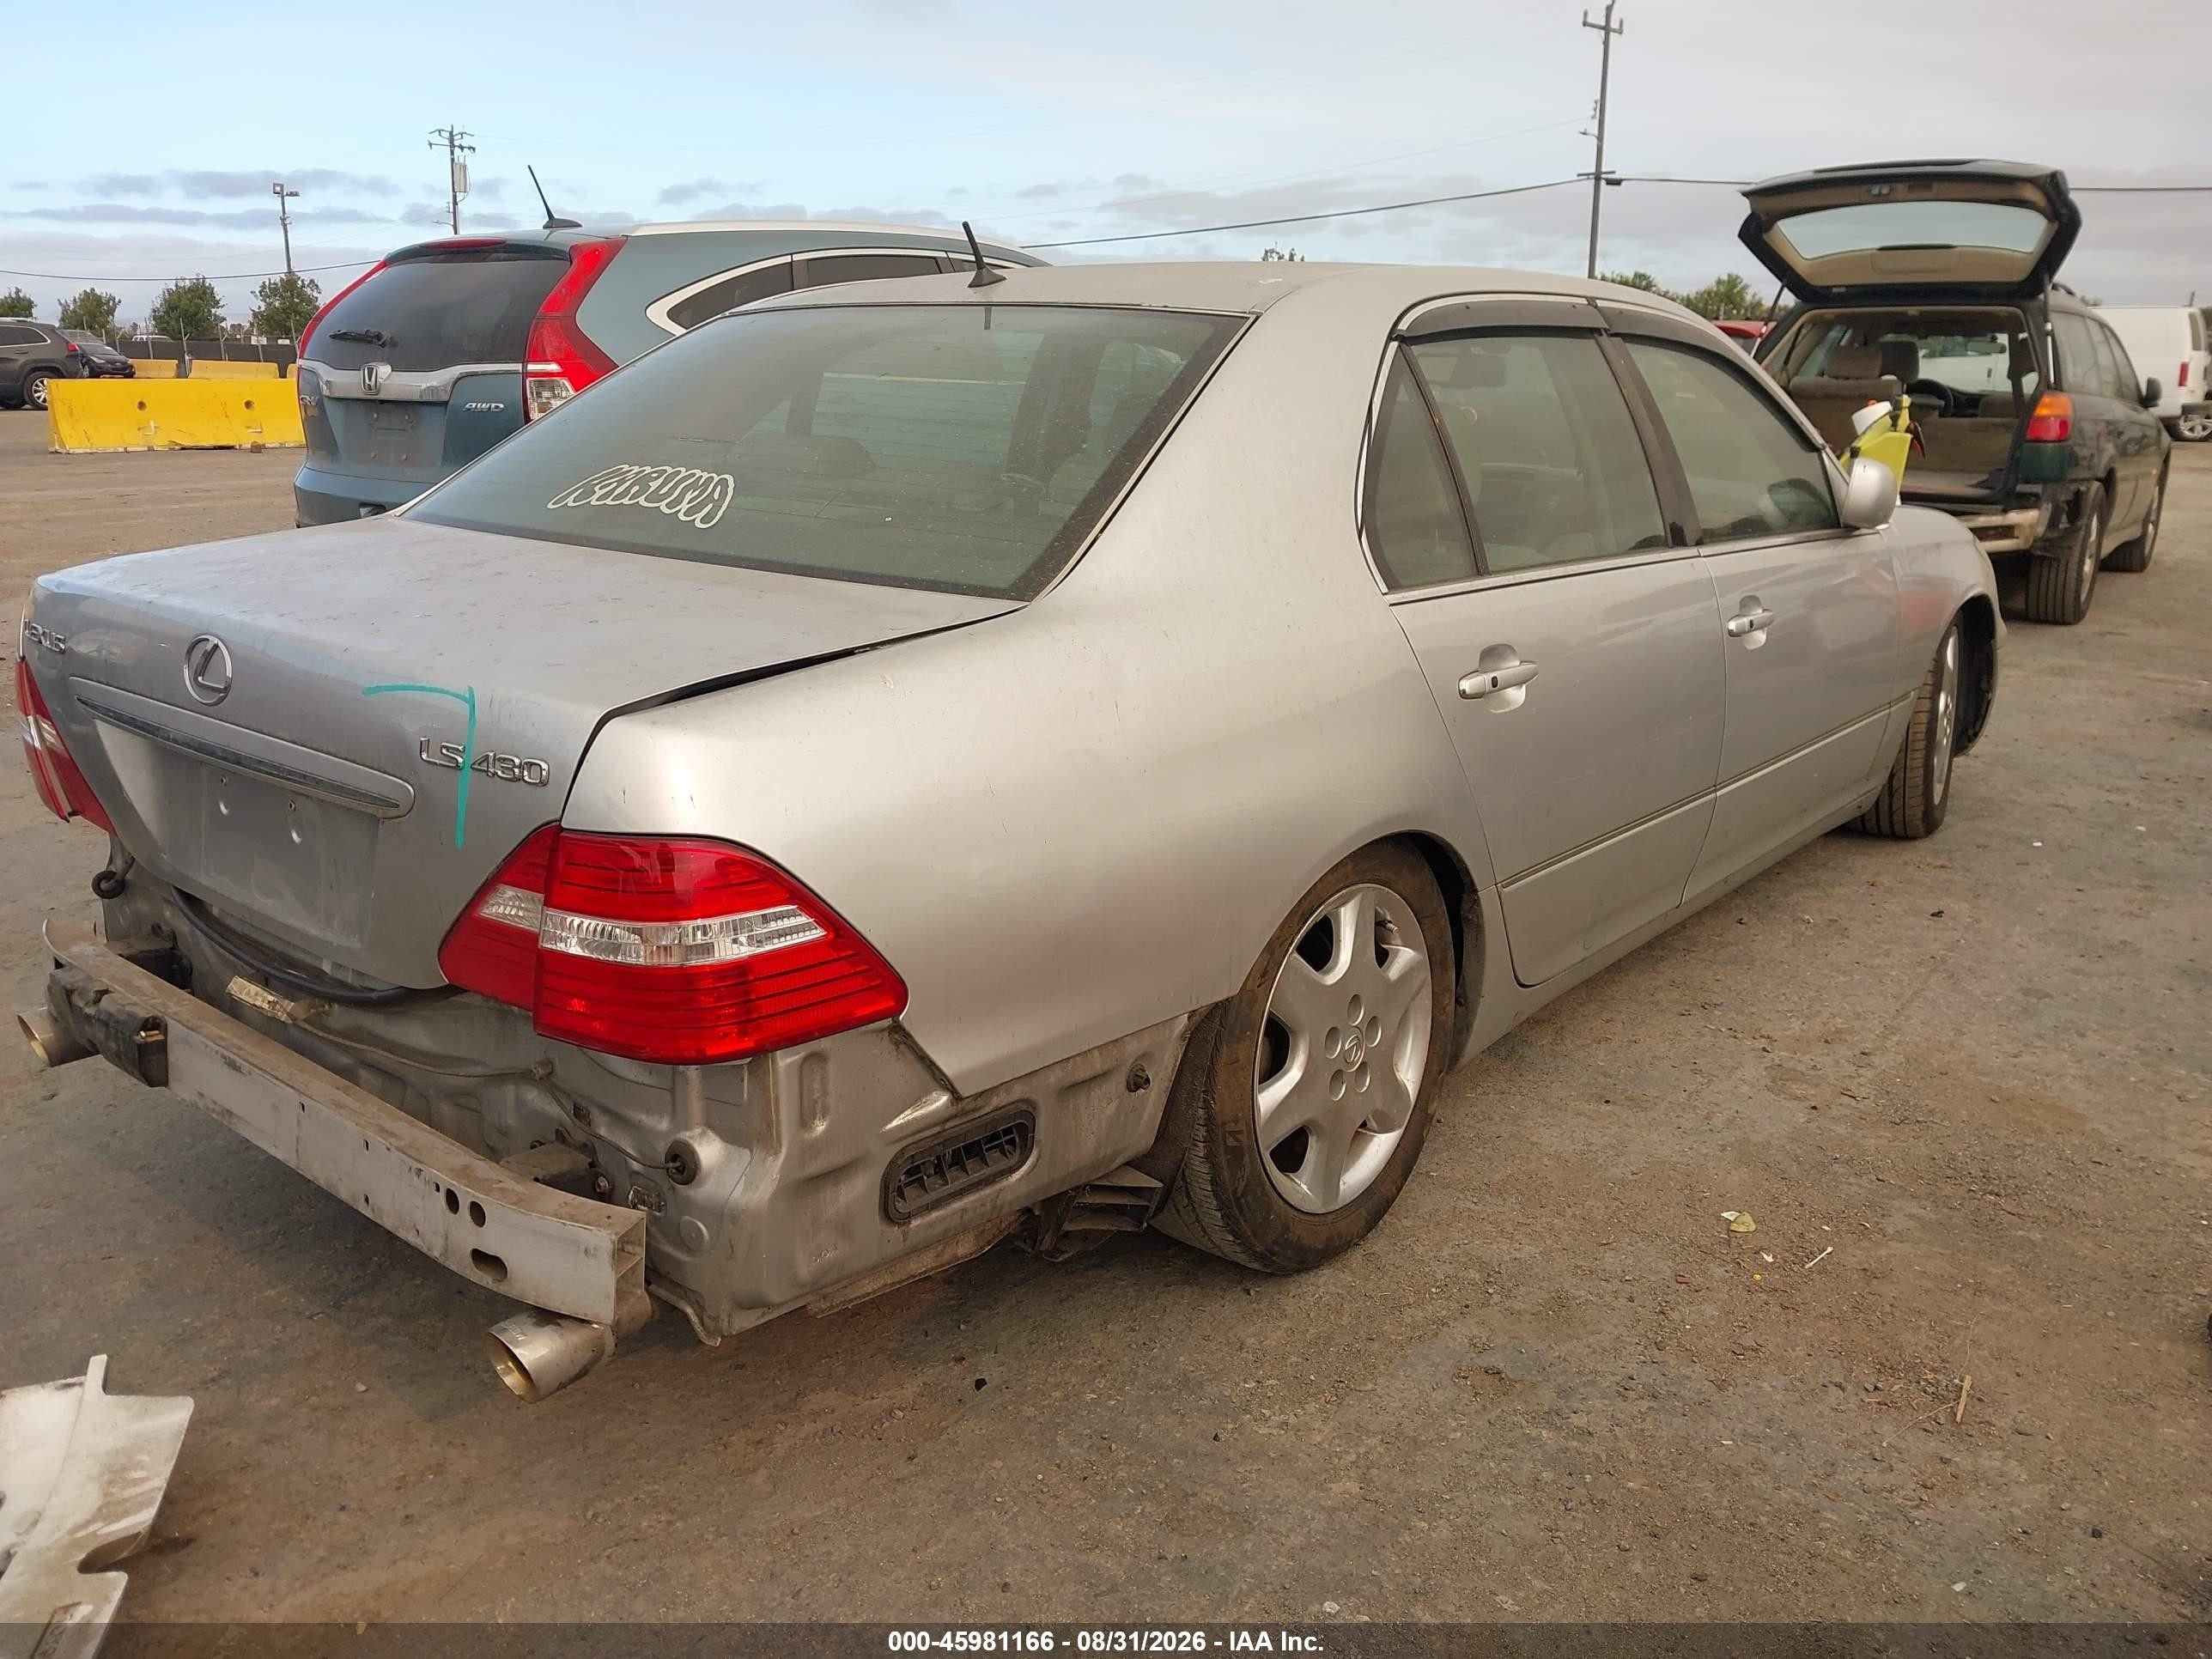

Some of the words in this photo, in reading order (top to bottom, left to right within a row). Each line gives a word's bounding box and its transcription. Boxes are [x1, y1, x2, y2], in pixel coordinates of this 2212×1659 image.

[462, 402, 505, 412] AWD
[24, 618, 66, 654] LEXUS
[419, 736, 465, 769] LS
[470, 750, 550, 787] 430
